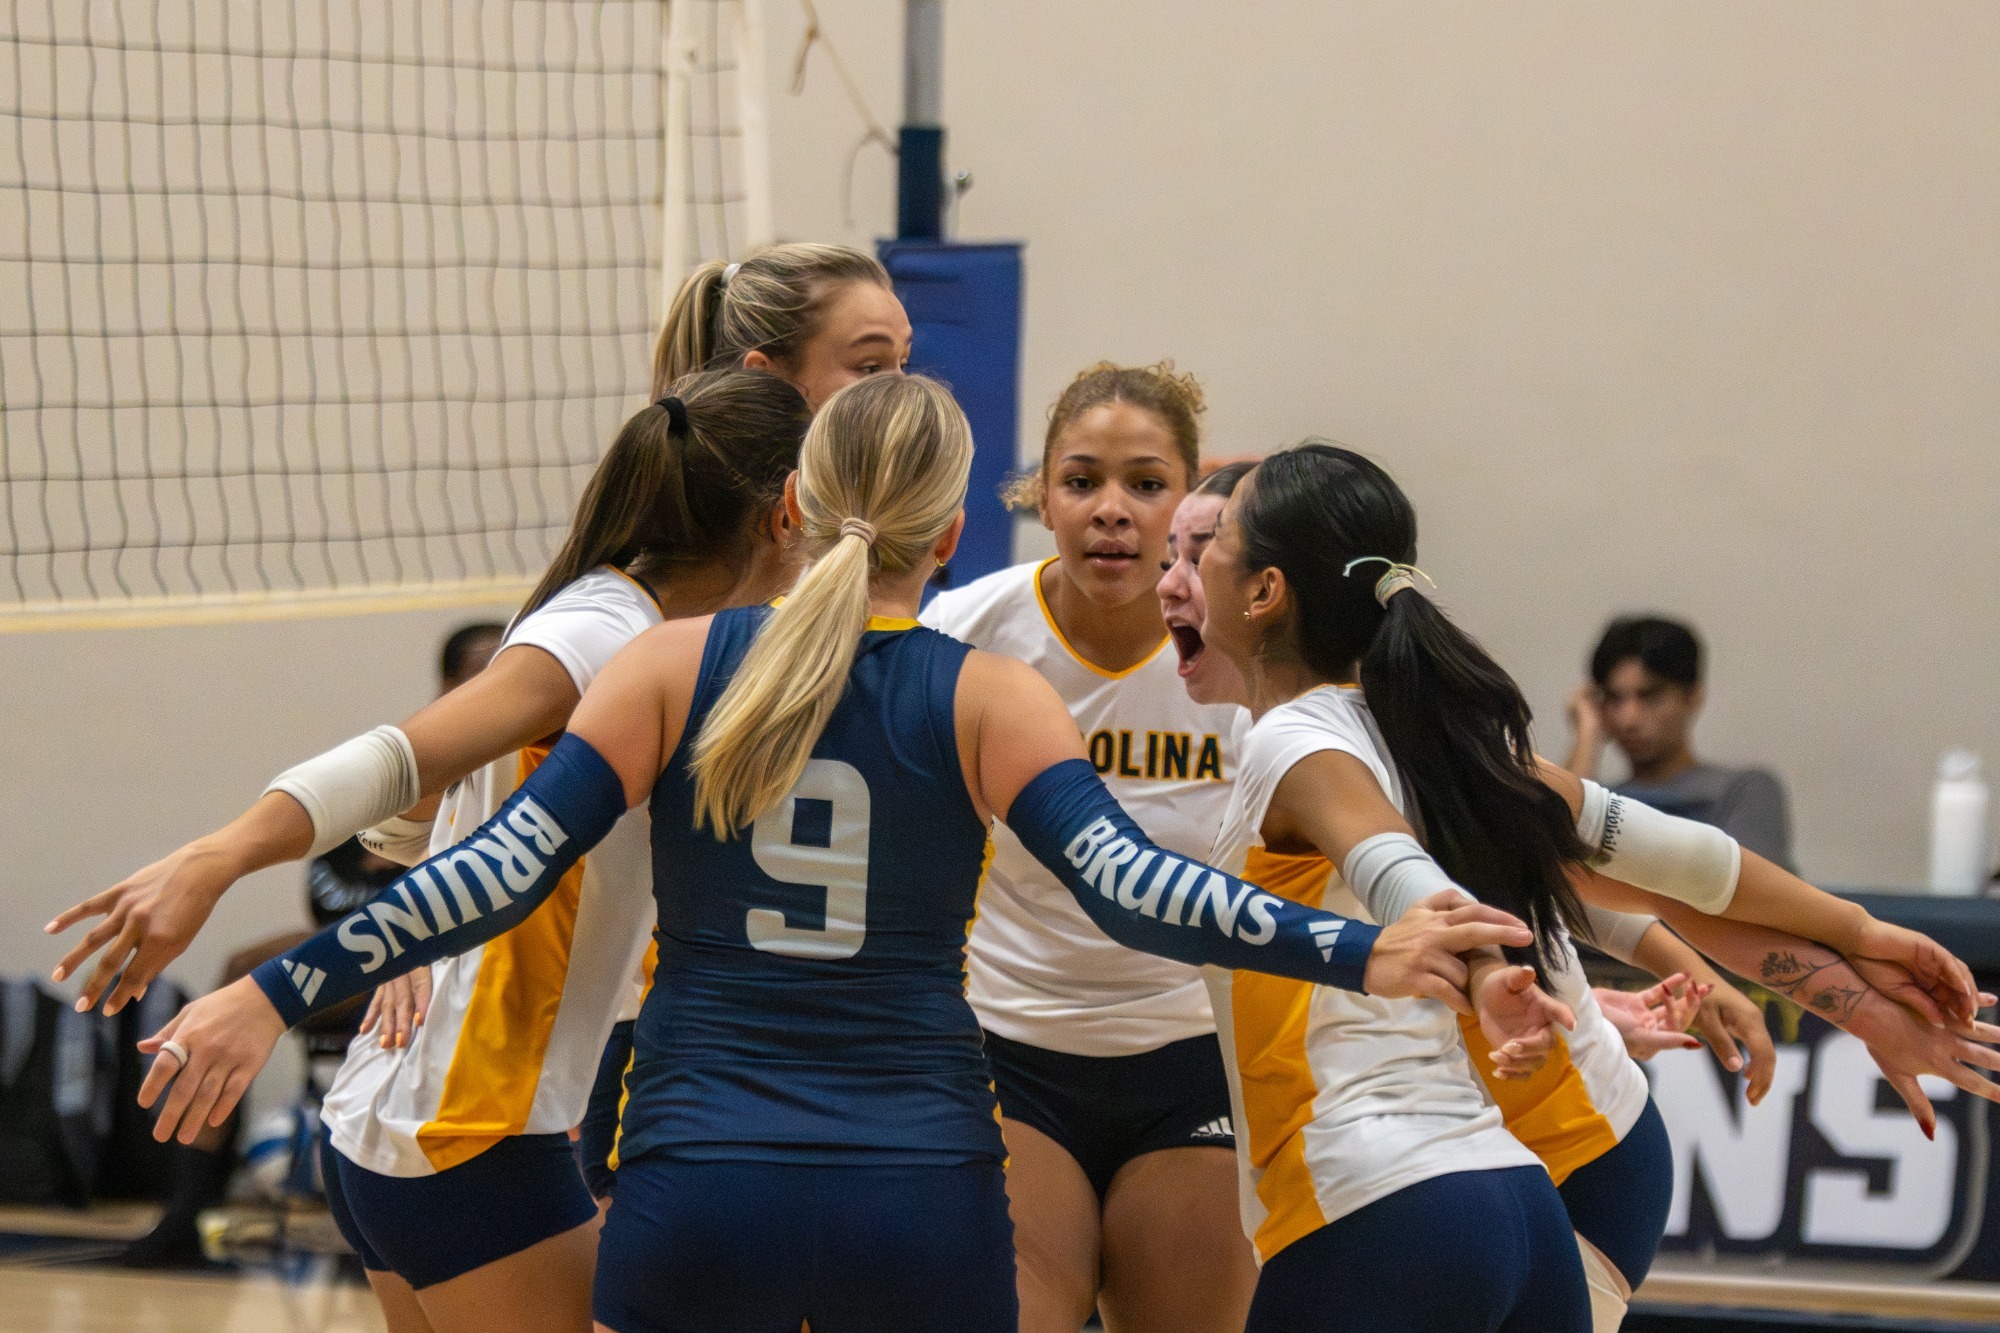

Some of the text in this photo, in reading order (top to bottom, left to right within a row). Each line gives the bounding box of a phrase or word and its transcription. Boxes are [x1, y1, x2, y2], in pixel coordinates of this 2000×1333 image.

[337, 796, 569, 974] BRUINS
[746, 758, 871, 960] 9
[1064, 815, 1285, 946] BRUINS
